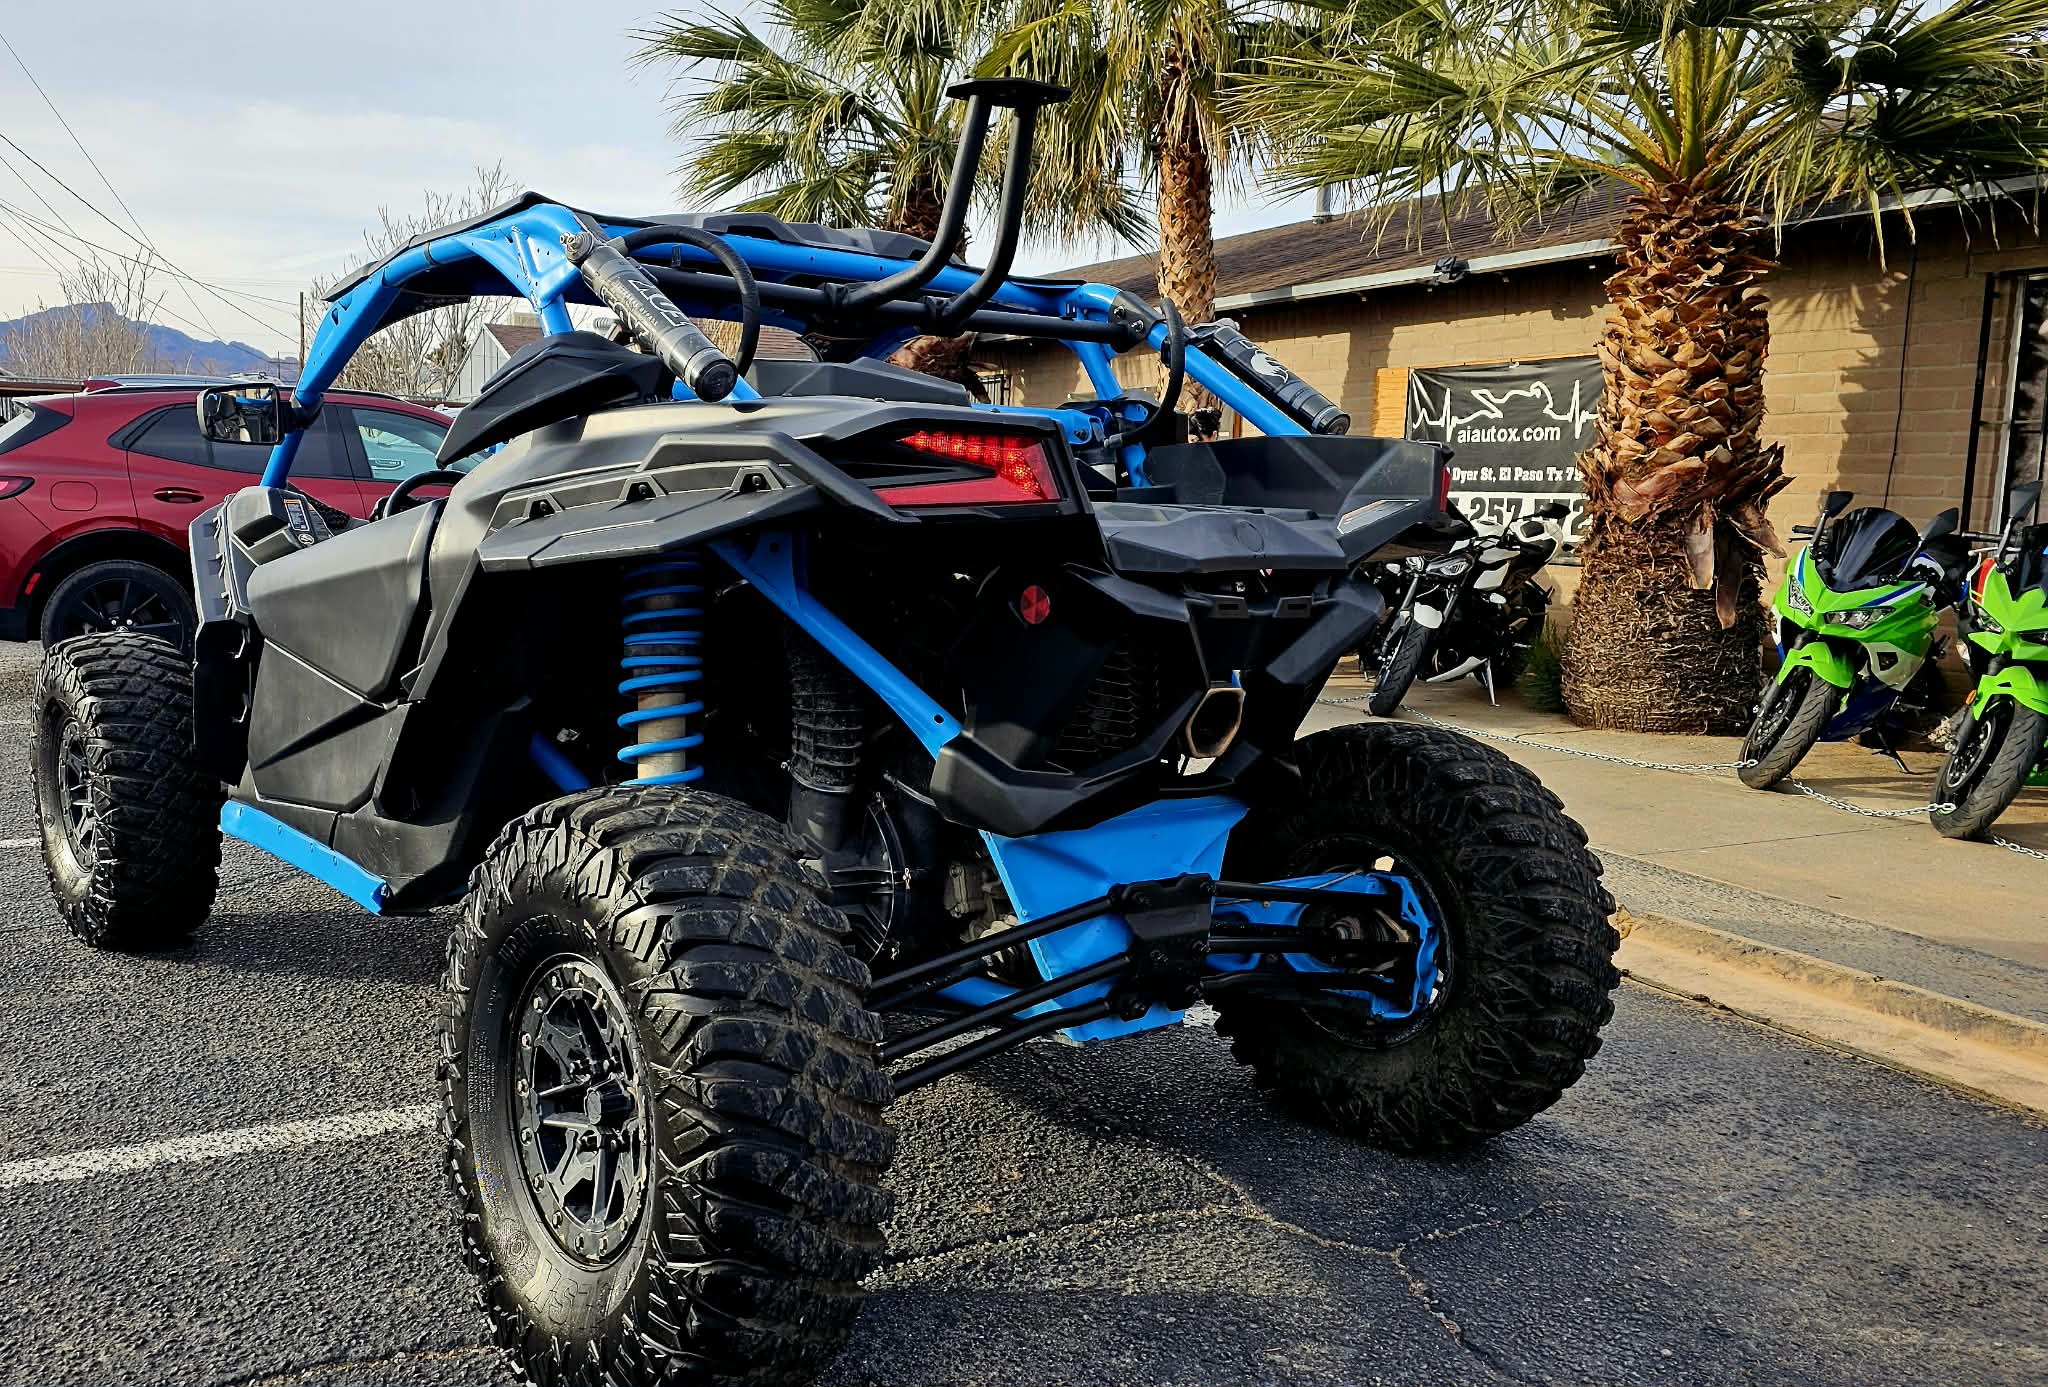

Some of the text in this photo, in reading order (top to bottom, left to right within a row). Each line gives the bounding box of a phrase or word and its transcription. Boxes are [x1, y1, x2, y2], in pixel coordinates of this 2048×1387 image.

[1457, 425, 1561, 443] aiautox.com
[1452, 467, 1478, 484] Dyer
[1480, 466, 1496, 483] St,
[1499, 467, 1512, 481] El
[1514, 467, 1544, 481] Paso
[1546, 466, 1564, 481] Tx
